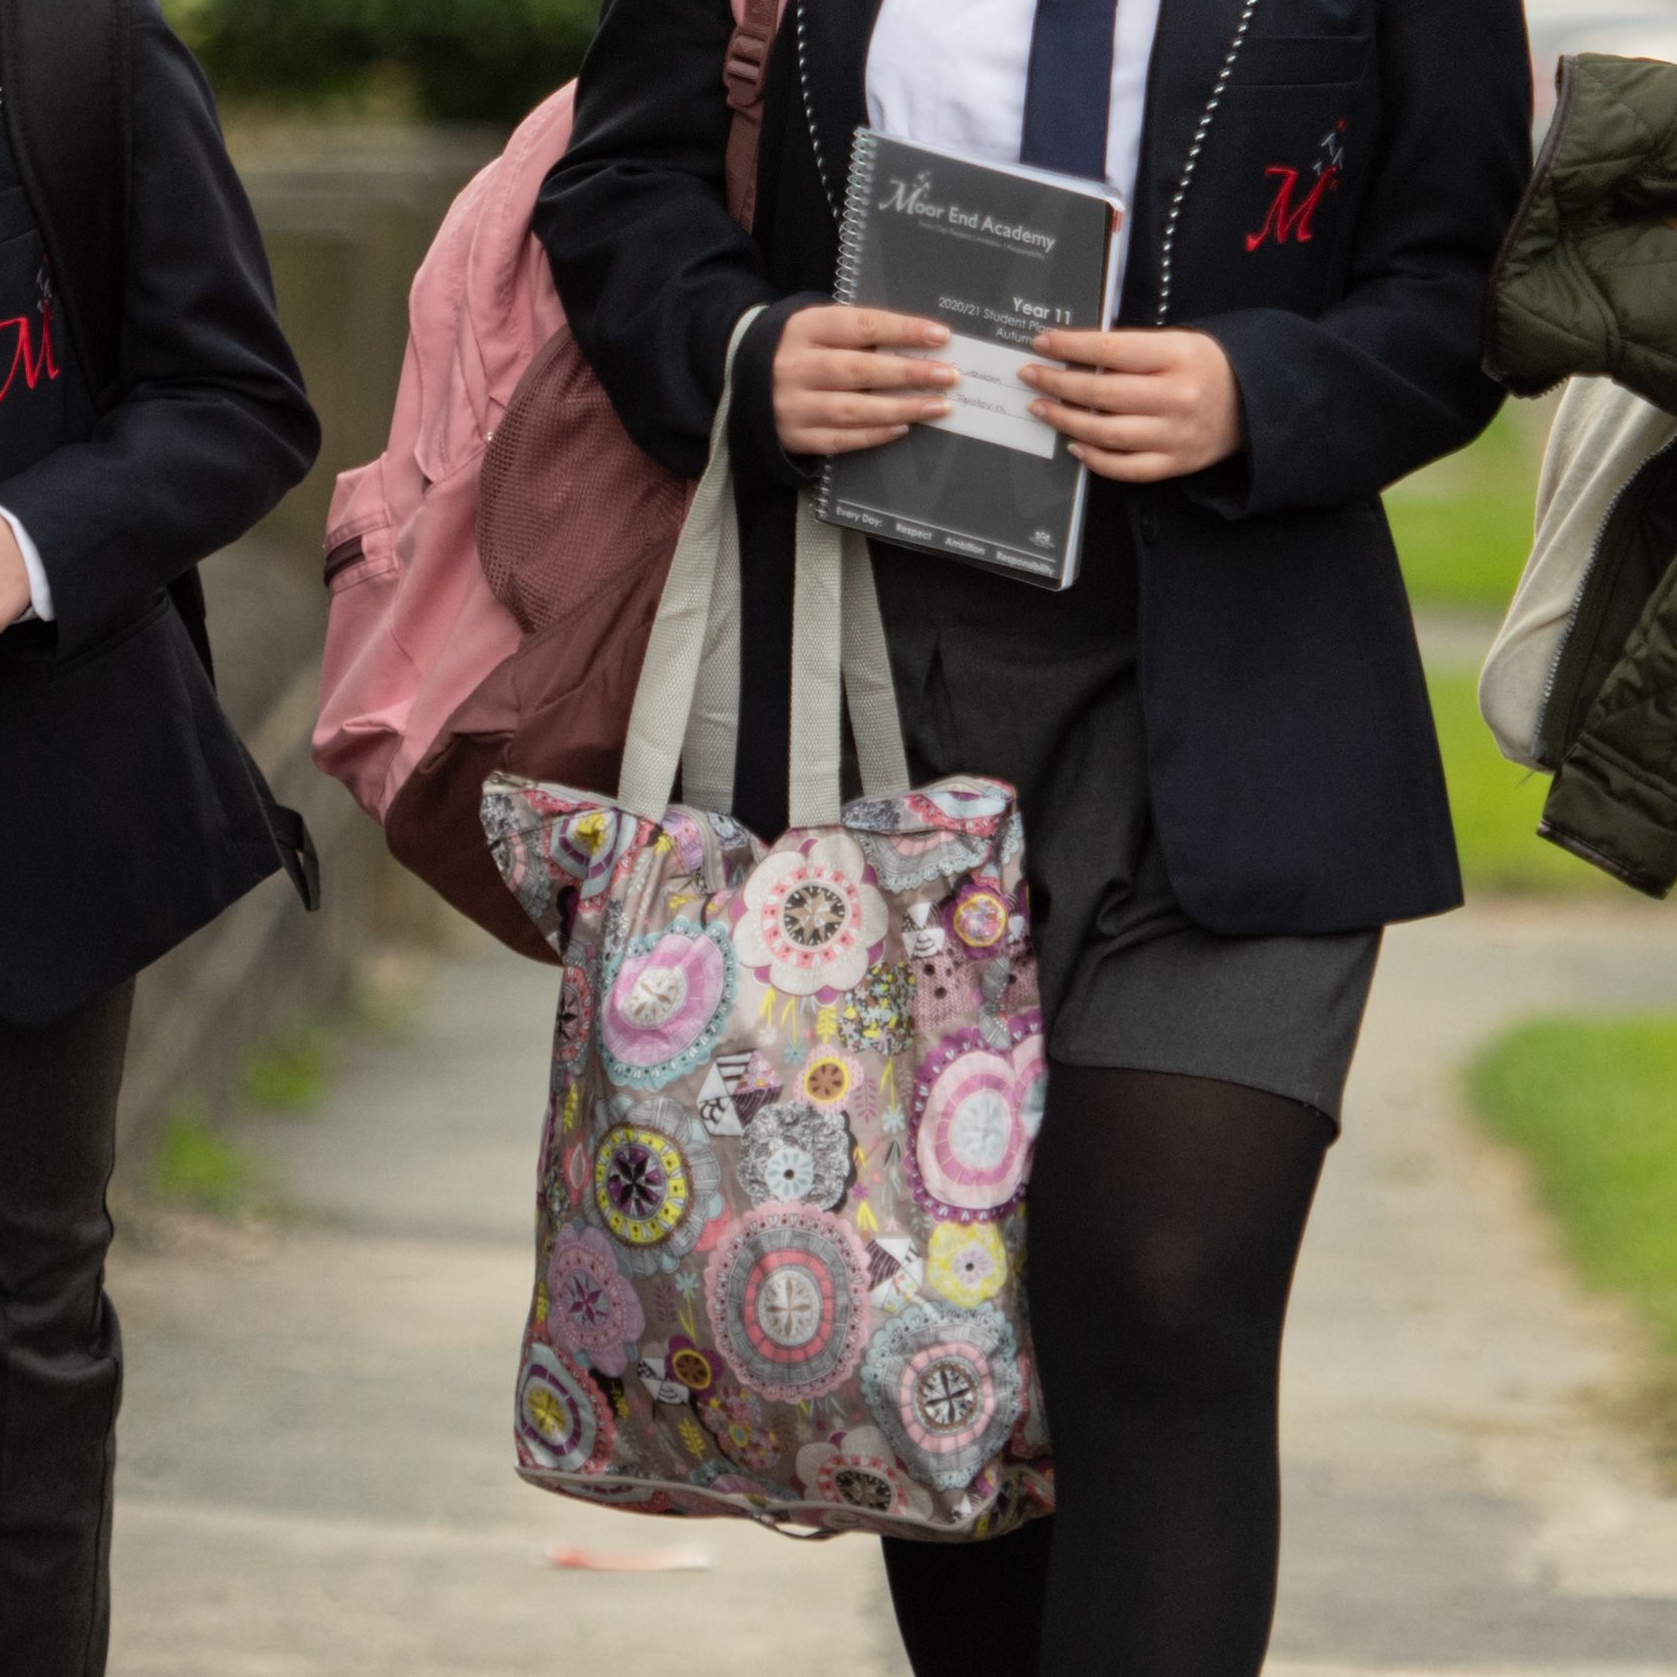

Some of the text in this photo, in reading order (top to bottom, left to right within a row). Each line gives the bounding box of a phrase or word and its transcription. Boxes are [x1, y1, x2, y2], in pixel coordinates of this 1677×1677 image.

[878, 178, 946, 218] Moor
[949, 207, 978, 229] End
[981, 217, 1056, 253] Academy
[938, 296, 981, 316] 2020/21
[983, 308, 1026, 329] Student
[1012, 296, 1072, 325] Year 11
[995, 327, 1033, 345] Autum
[835, 505, 860, 522] Every
[895, 523, 932, 541] Respect
[945, 536, 985, 556] Ambition
[996, 550, 1054, 576] Responsibility
